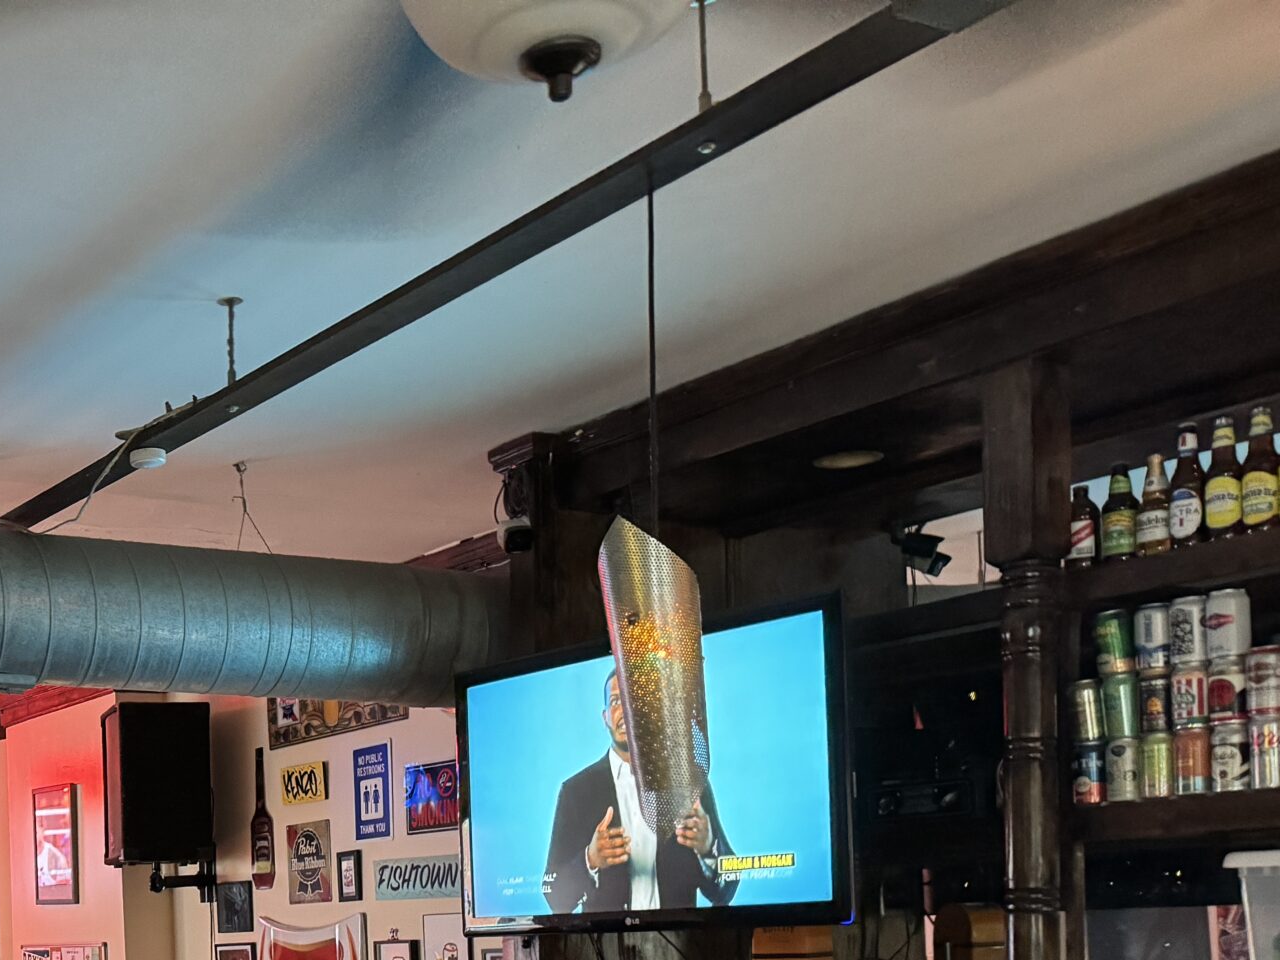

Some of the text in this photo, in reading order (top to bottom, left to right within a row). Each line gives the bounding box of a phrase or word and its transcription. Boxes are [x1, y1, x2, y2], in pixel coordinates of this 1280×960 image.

[358, 752, 383, 765] NO PUBLIC
[357, 763, 385, 777] RESTROOMS
[282, 767, 318, 800] KENZO
[411, 799, 458, 829] SMOKIN
[360, 822, 386, 835] THANK YOU
[297, 836, 317, 855] Pabst
[291, 855, 326, 870] Blue Ribbon
[377, 862, 460, 891] FISHTOWN
